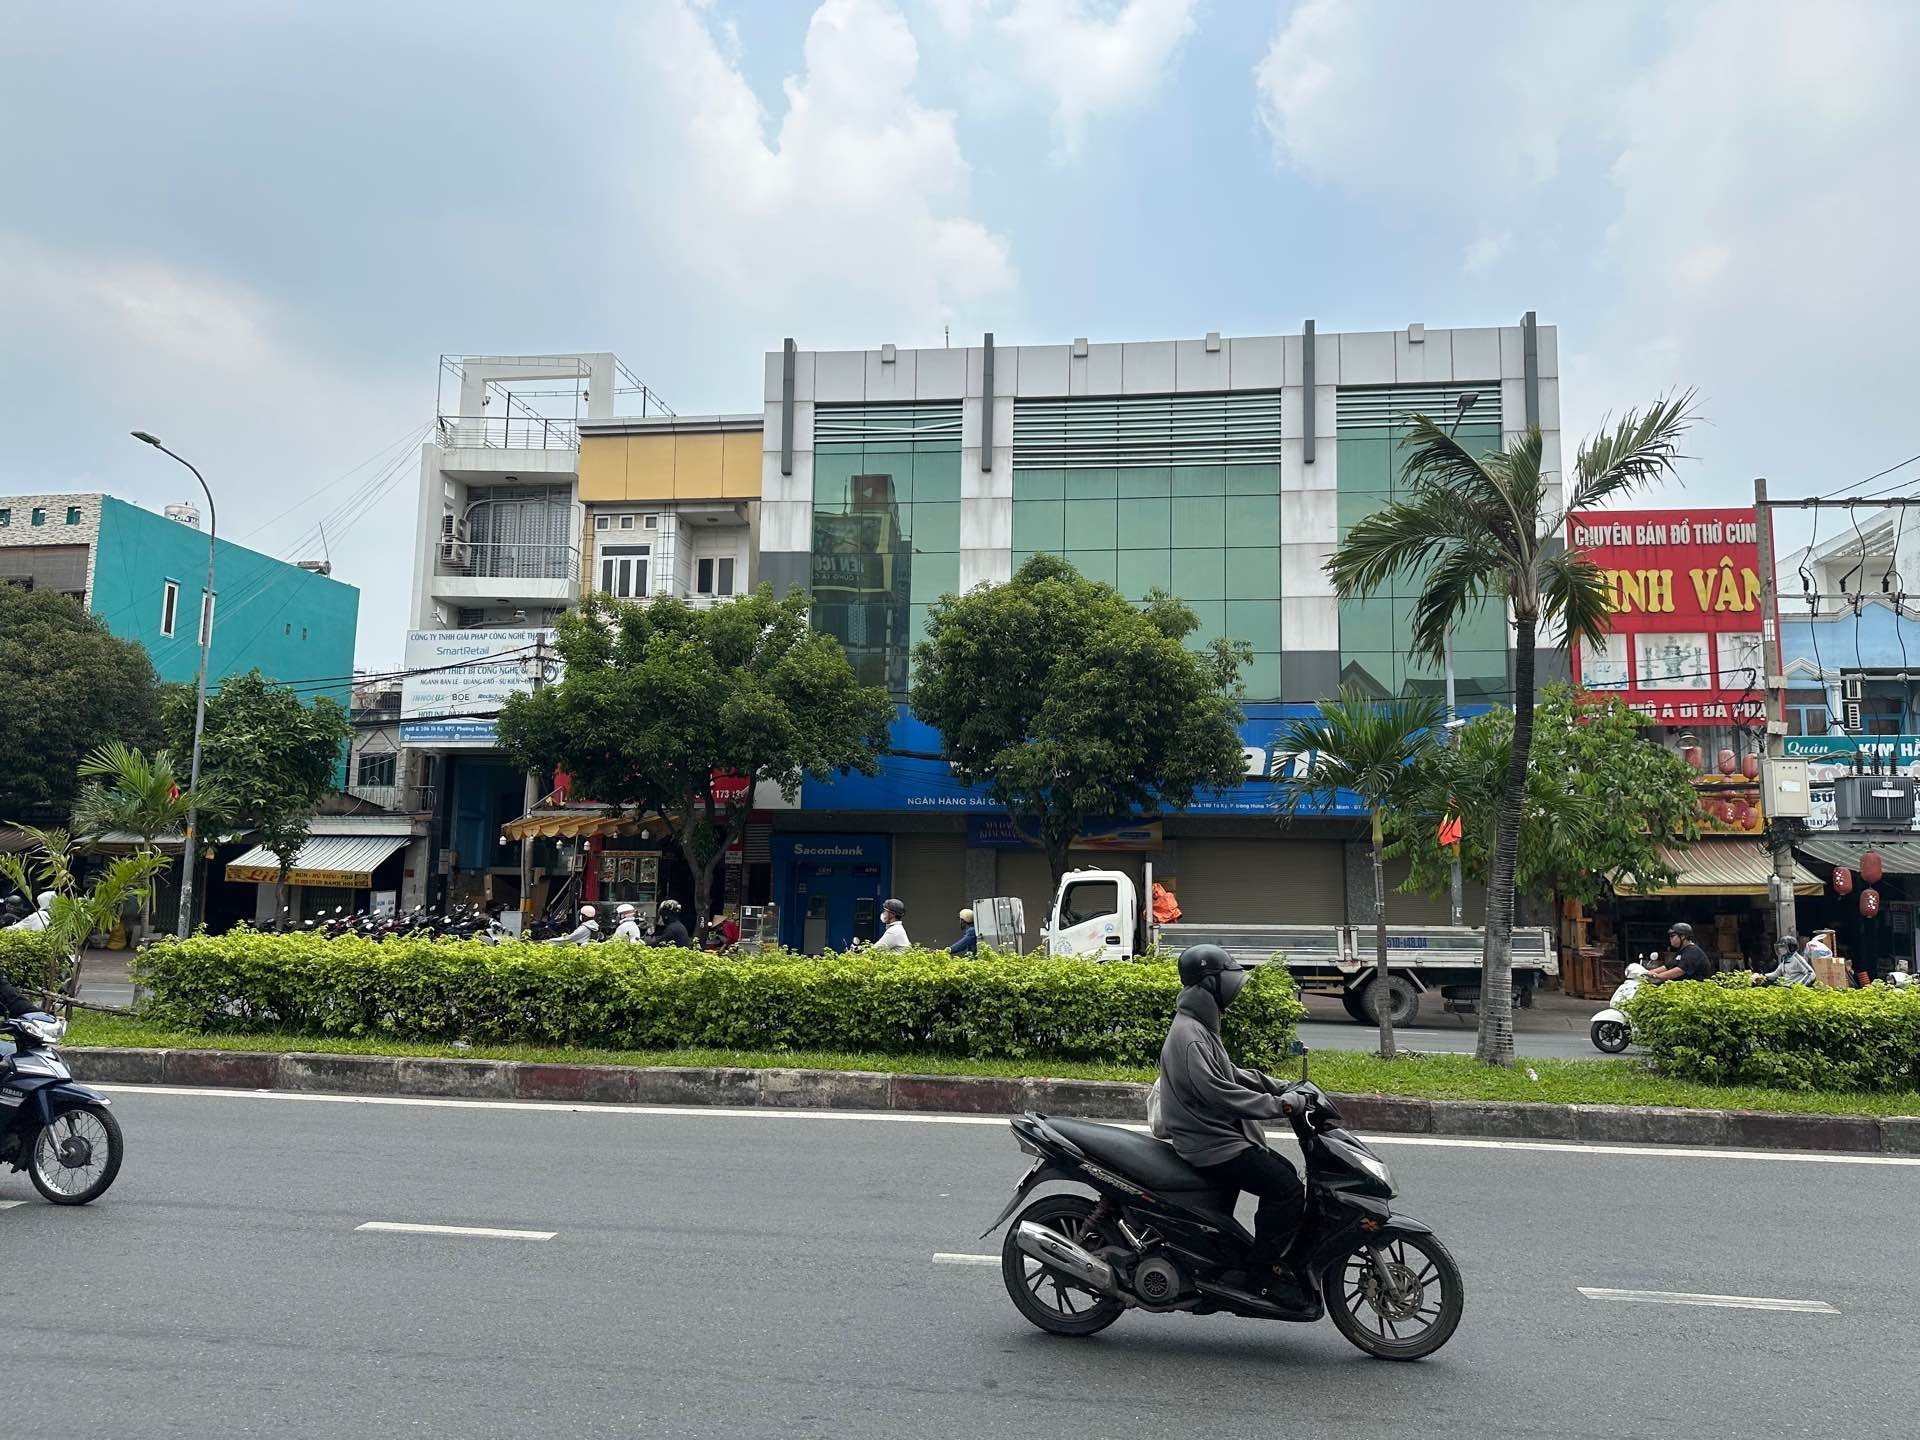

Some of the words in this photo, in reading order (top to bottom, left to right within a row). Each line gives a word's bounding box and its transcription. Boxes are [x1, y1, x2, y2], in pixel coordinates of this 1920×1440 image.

[1574, 522, 1632, 546] CHUYÊN
[1636, 521, 1667, 546] BÁN
[1671, 518, 1691, 545] ĐỒ
[1694, 519, 1723, 545] THỜ
[1726, 519, 1757, 544] CÚN
[1597, 568, 1676, 613] INH
[411, 631, 429, 641] CÔNG
[430, 633, 437, 641] TY
[439, 632, 455, 641] TNHH
[489, 630, 507, 640] CÔNG
[436, 646, 490, 656] SmartRetail
[452, 693, 470, 702] BOE
[1662, 703, 1675, 718] A
[1679, 703, 1698, 718] DI
[1787, 741, 1829, 756] Quán
[1858, 743, 1895, 757] KIM
[907, 795, 936, 805] NGÂN
[938, 796, 967, 805] HÀNG
[969, 795, 986, 806] SÀI
[793, 843, 864, 856] Sacombank
